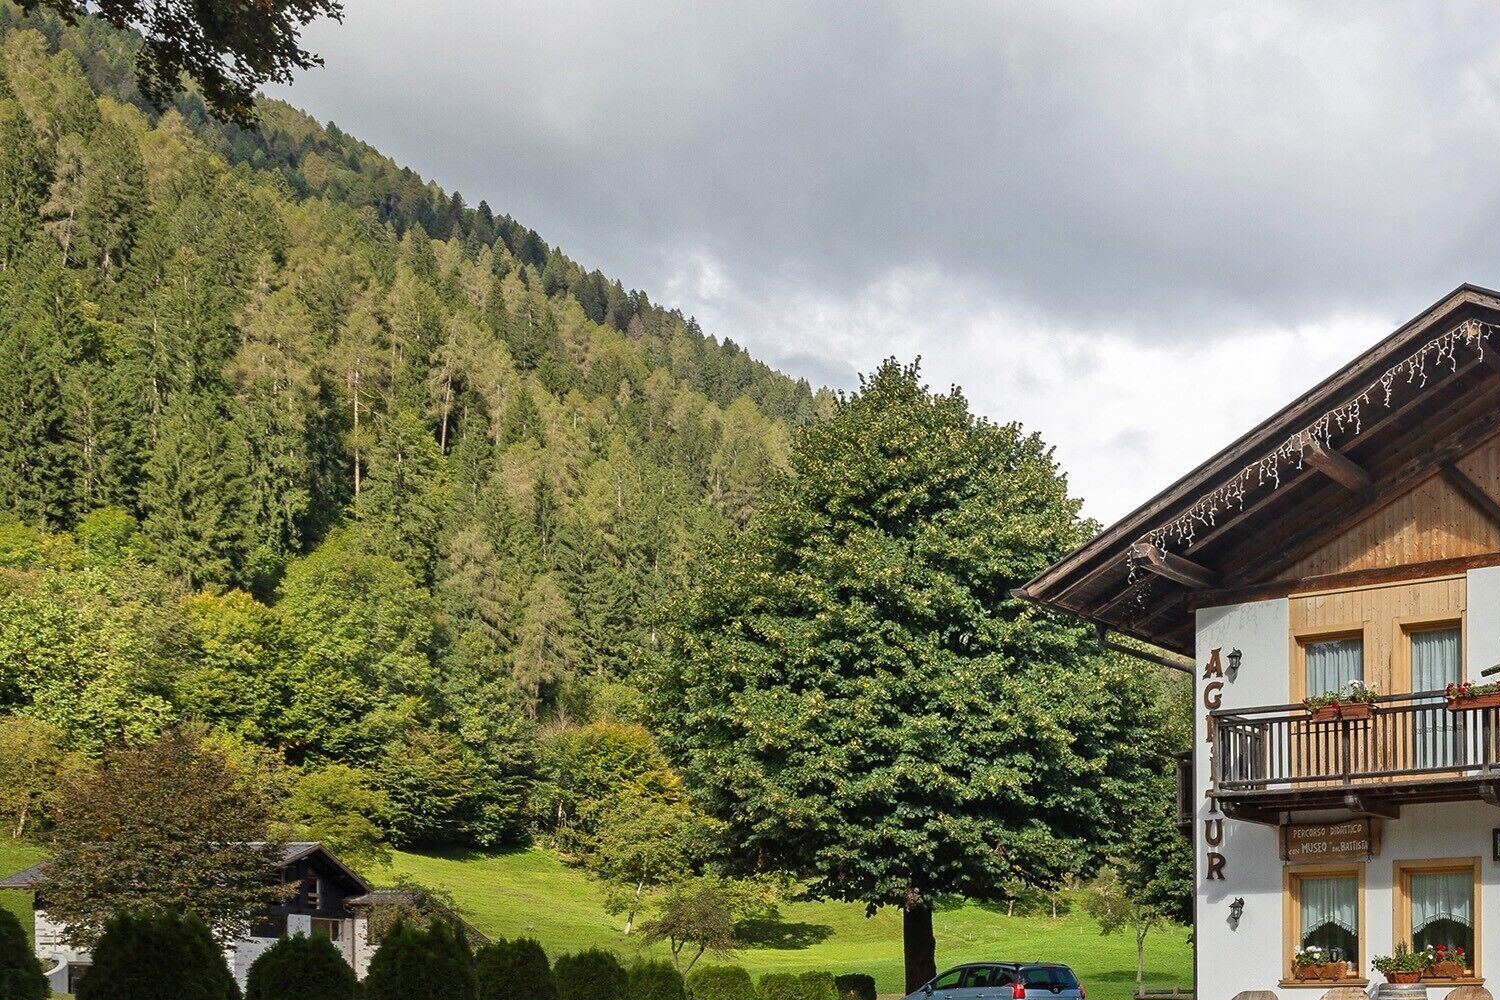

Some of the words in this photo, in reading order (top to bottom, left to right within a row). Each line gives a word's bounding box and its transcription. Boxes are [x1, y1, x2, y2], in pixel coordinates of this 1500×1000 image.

[1203, 647, 1226, 880] AGTUR
[1293, 828, 1326, 838] PERCORSO
[1330, 824, 1362, 835] DIDATTICO
[1301, 842, 1327, 854] MUSEO
[1340, 840, 1368, 852] BATTISTA
